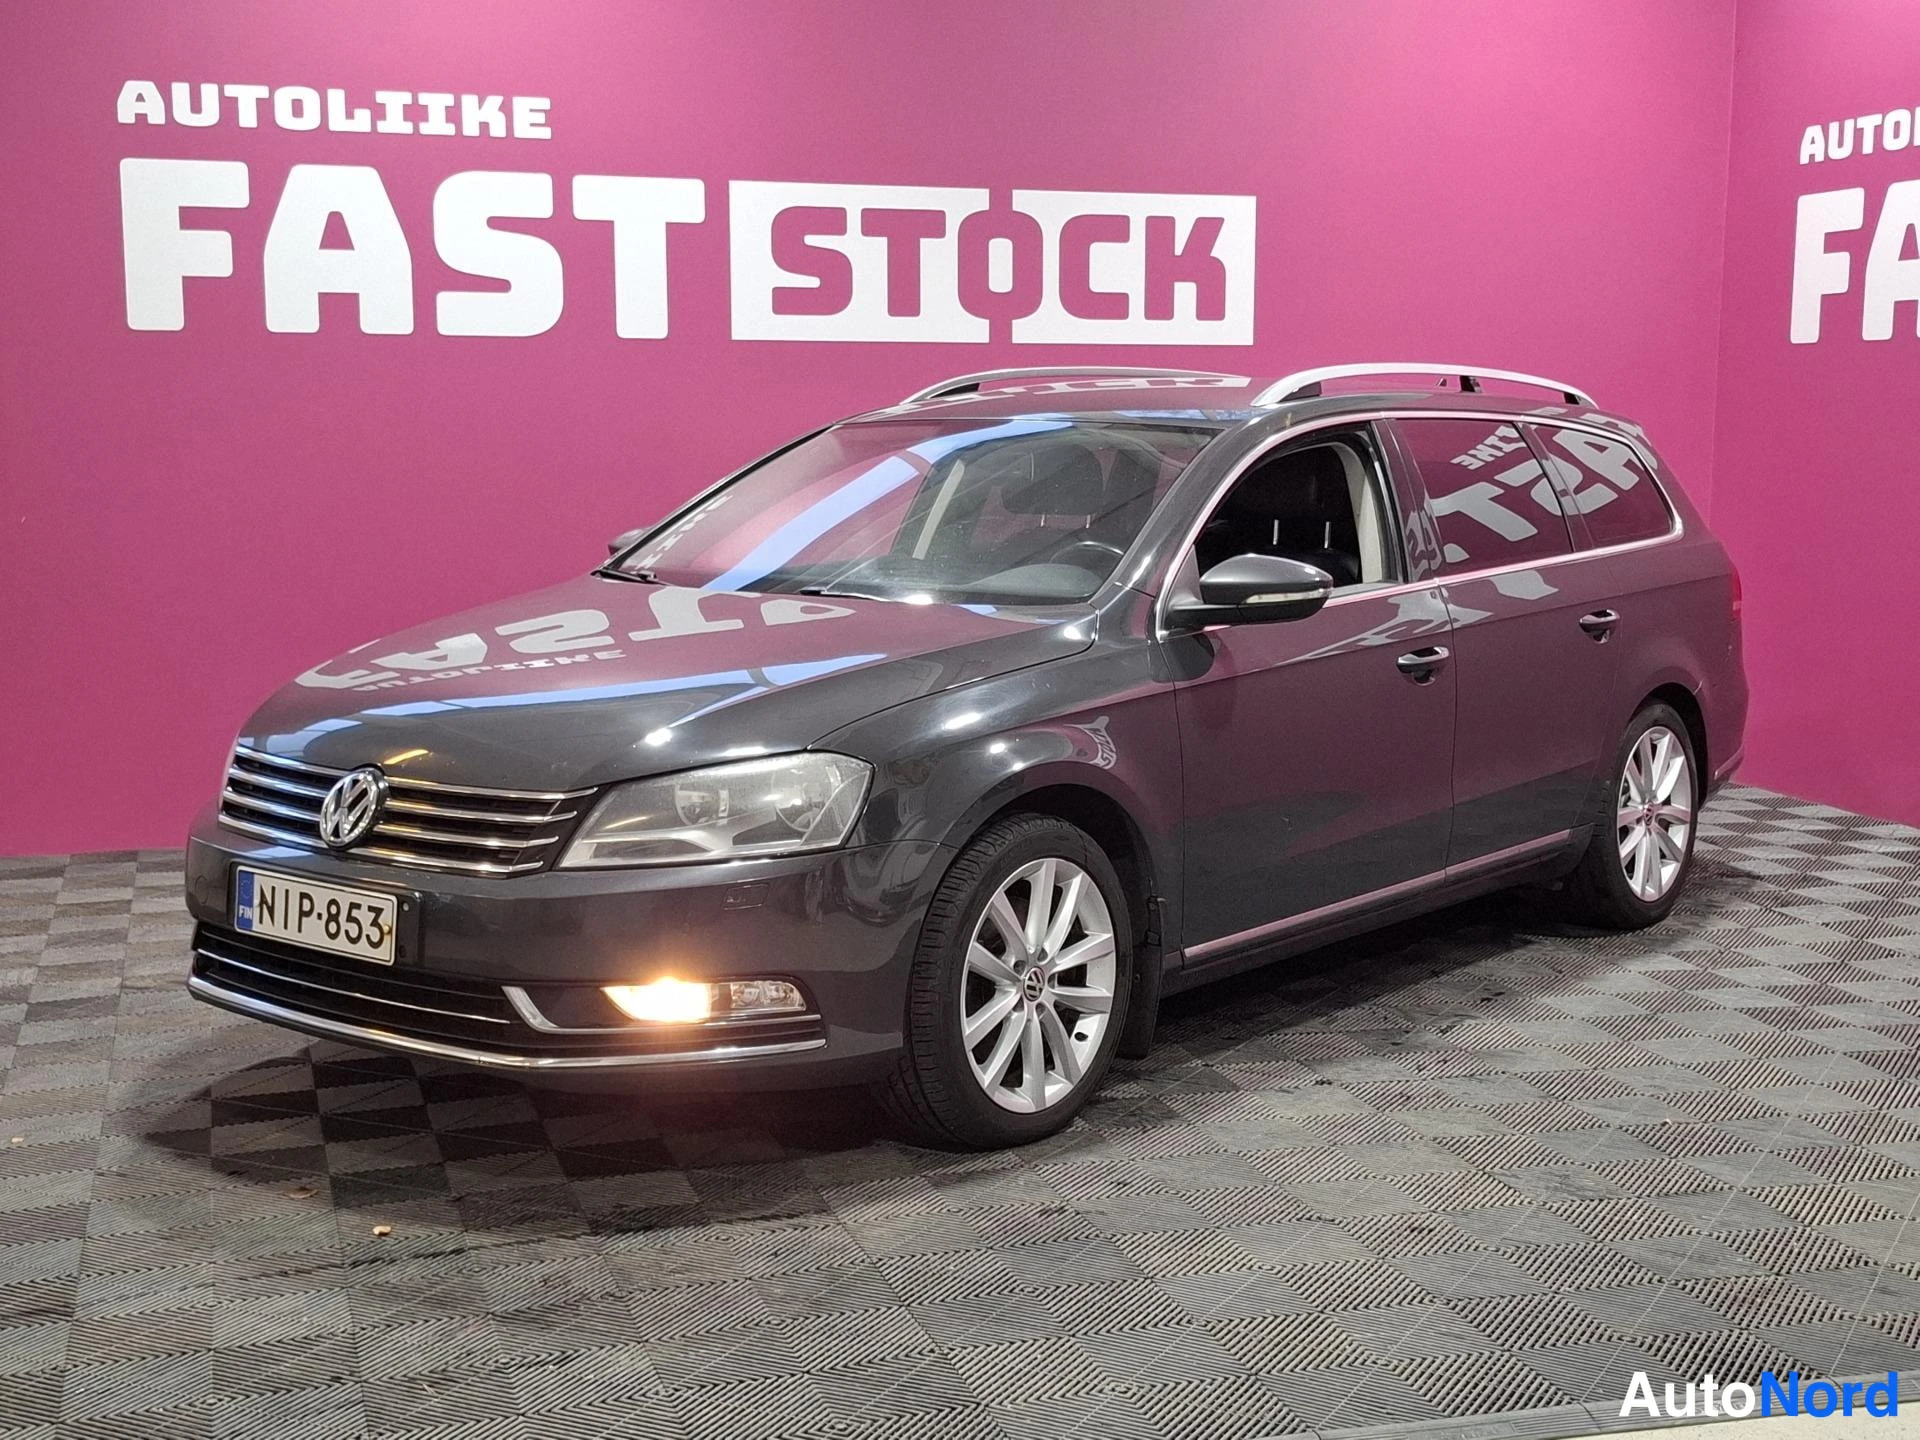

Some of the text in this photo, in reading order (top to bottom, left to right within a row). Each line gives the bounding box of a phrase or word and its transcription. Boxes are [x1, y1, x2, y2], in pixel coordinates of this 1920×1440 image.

[117, 80, 551, 139] AUTOLIIKE
[1799, 106, 1920, 165] AUTO
[119, 157, 1226, 339] FAST STOCK
[239, 904, 253, 920] FIN
[258, 884, 385, 950] NIP-853
